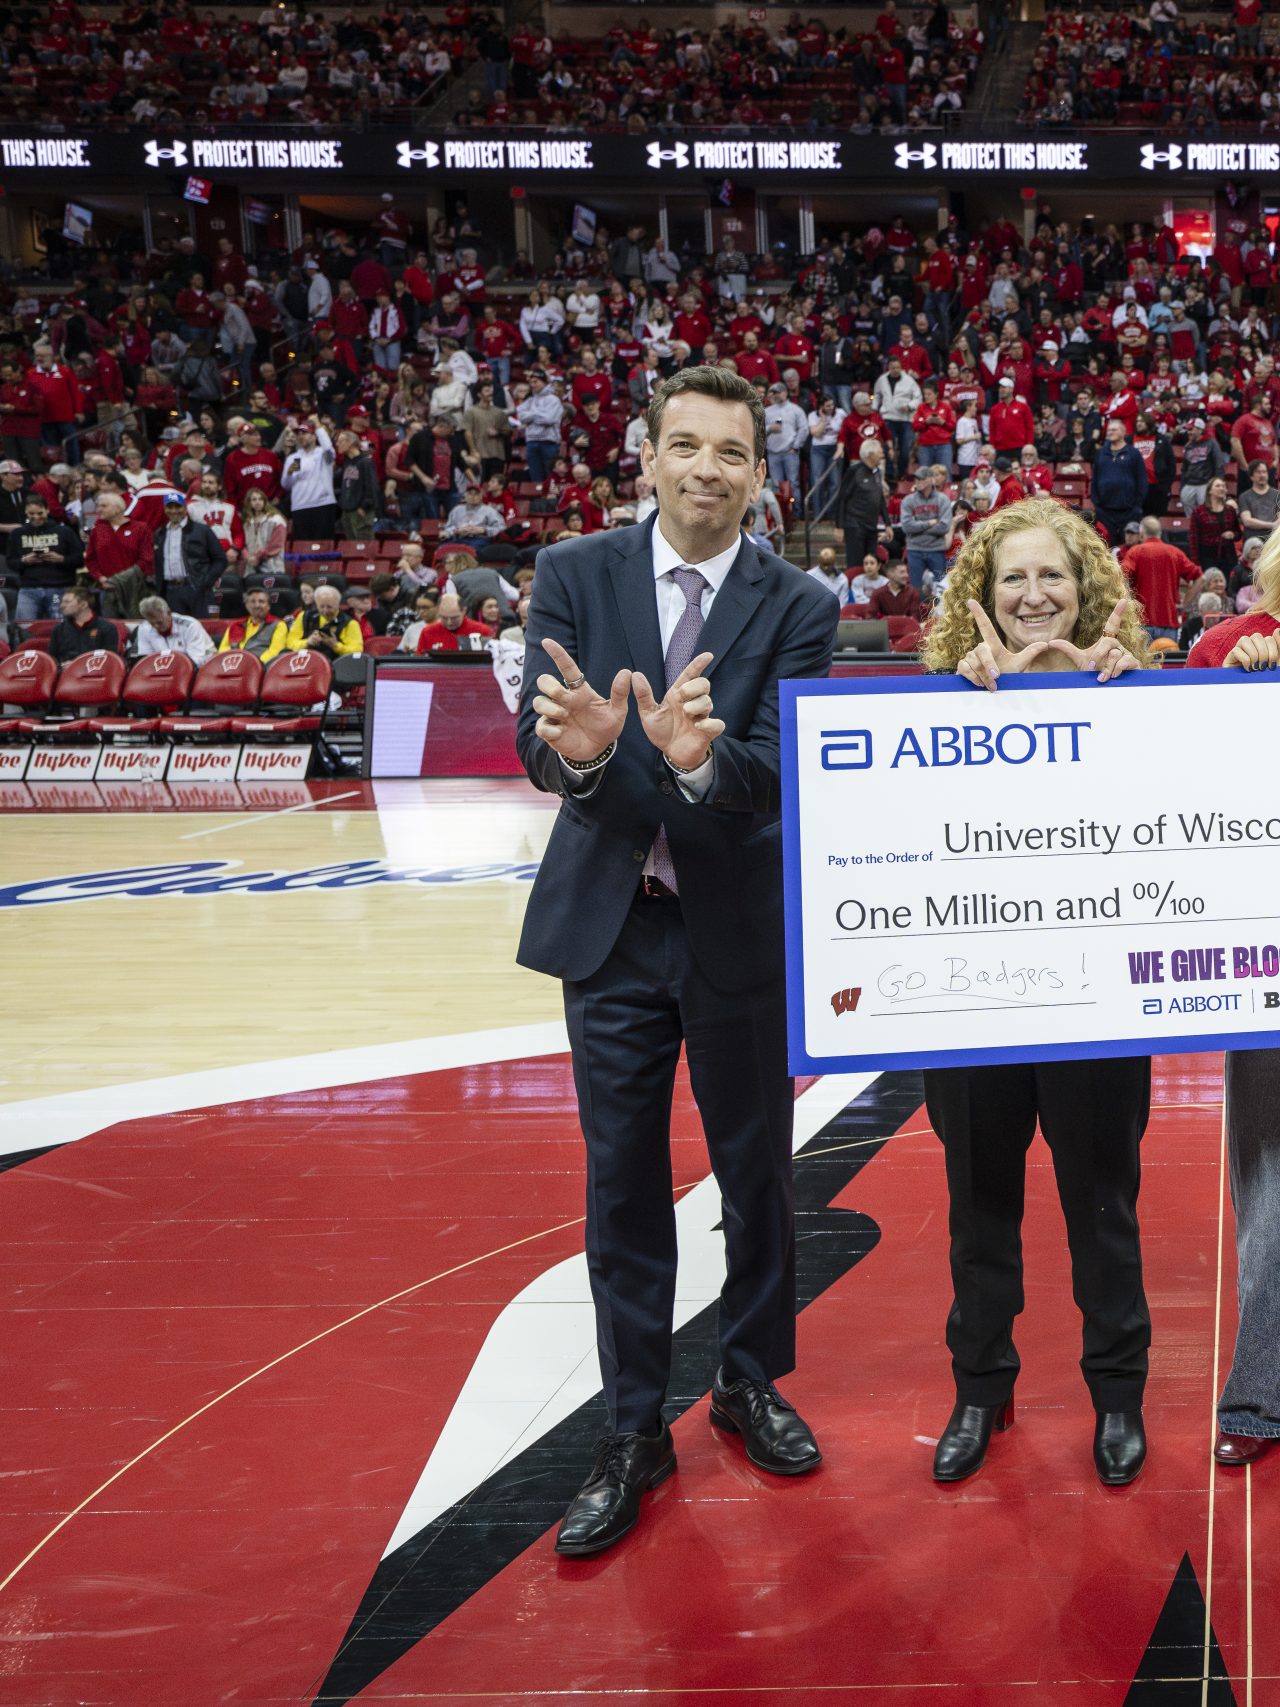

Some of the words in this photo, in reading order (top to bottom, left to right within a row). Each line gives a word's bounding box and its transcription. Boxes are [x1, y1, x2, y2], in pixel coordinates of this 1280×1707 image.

[1, 139, 35, 166] THIS
[193, 140, 254, 167] PROTECT
[255, 140, 289, 167] THIS
[444, 141, 504, 168] PROTECT
[506, 141, 539, 168] THIS
[694, 142, 754, 169] PROTECT
[756, 142, 788, 169] THIS
[942, 143, 1002, 170] PROTECT
[1003, 143, 1035, 170] THIS
[1187, 144, 1246, 170] PROTECT
[1248, 144, 1280, 170] THIS
[890, 722, 1091, 768] ABBOTT
[34, 753, 91, 771] HyVee
[174, 753, 232, 771] HyVee
[244, 753, 302, 771] HyVee
[828, 855, 848, 867] Pay
[851, 854, 862, 865] to
[865, 853, 884, 864] the
[886, 852, 918, 863] Order
[921, 851, 934, 861] of
[944, 818, 1121, 855] University
[1133, 814, 1167, 845] of
[835, 899, 912, 930] One
[925, 893, 1043, 926] Million
[1055, 888, 1121, 920] and
[1128, 951, 1164, 984] WE
[1171, 947, 1226, 982] GIVE
[1168, 994, 1242, 1013] ABBOTT
